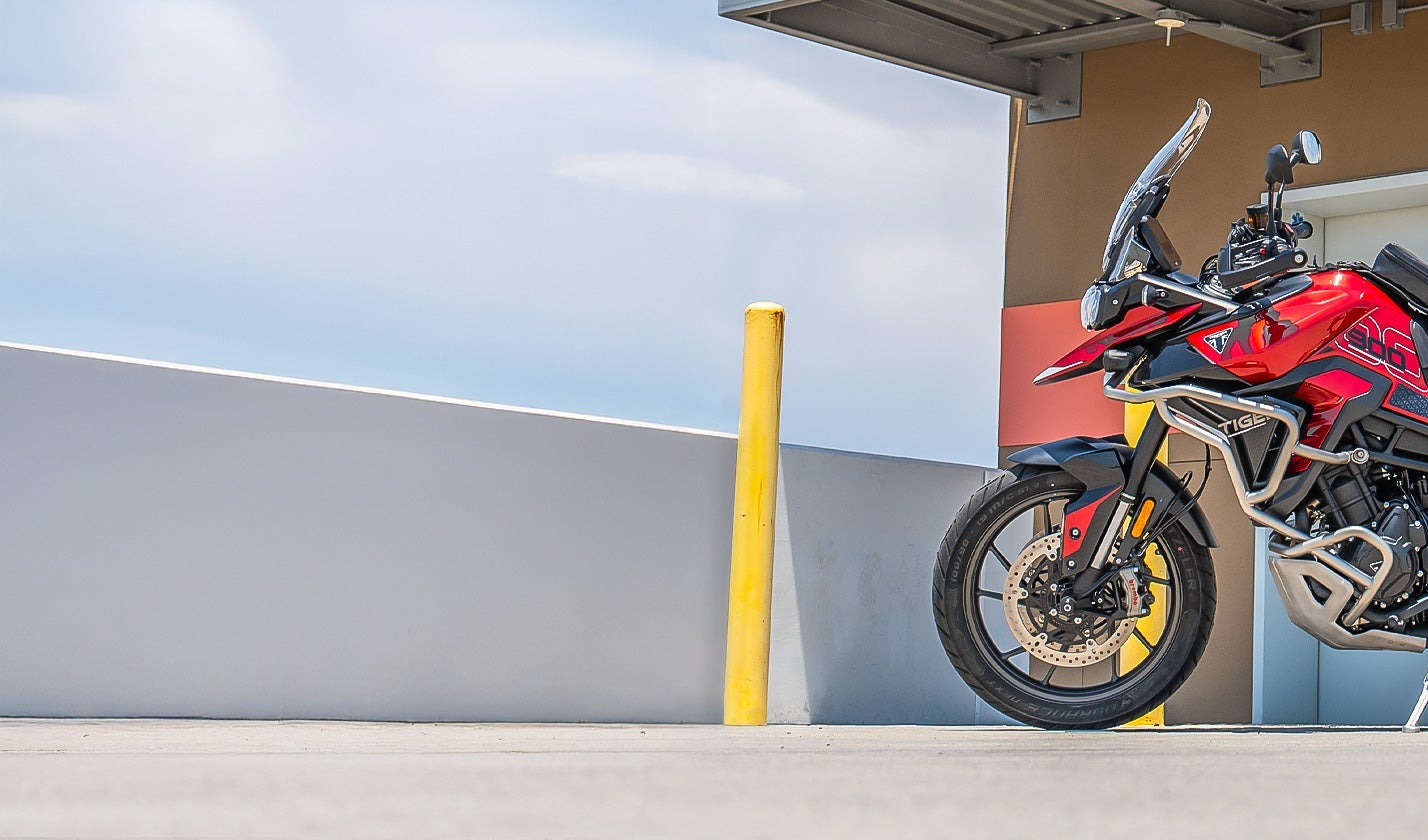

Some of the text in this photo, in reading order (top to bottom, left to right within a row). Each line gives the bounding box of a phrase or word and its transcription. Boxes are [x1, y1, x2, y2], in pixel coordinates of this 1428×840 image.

[1347, 328, 1406, 371] 900
[1217, 413, 1271, 435] TIGE
[1127, 578, 1139, 606] brembo
